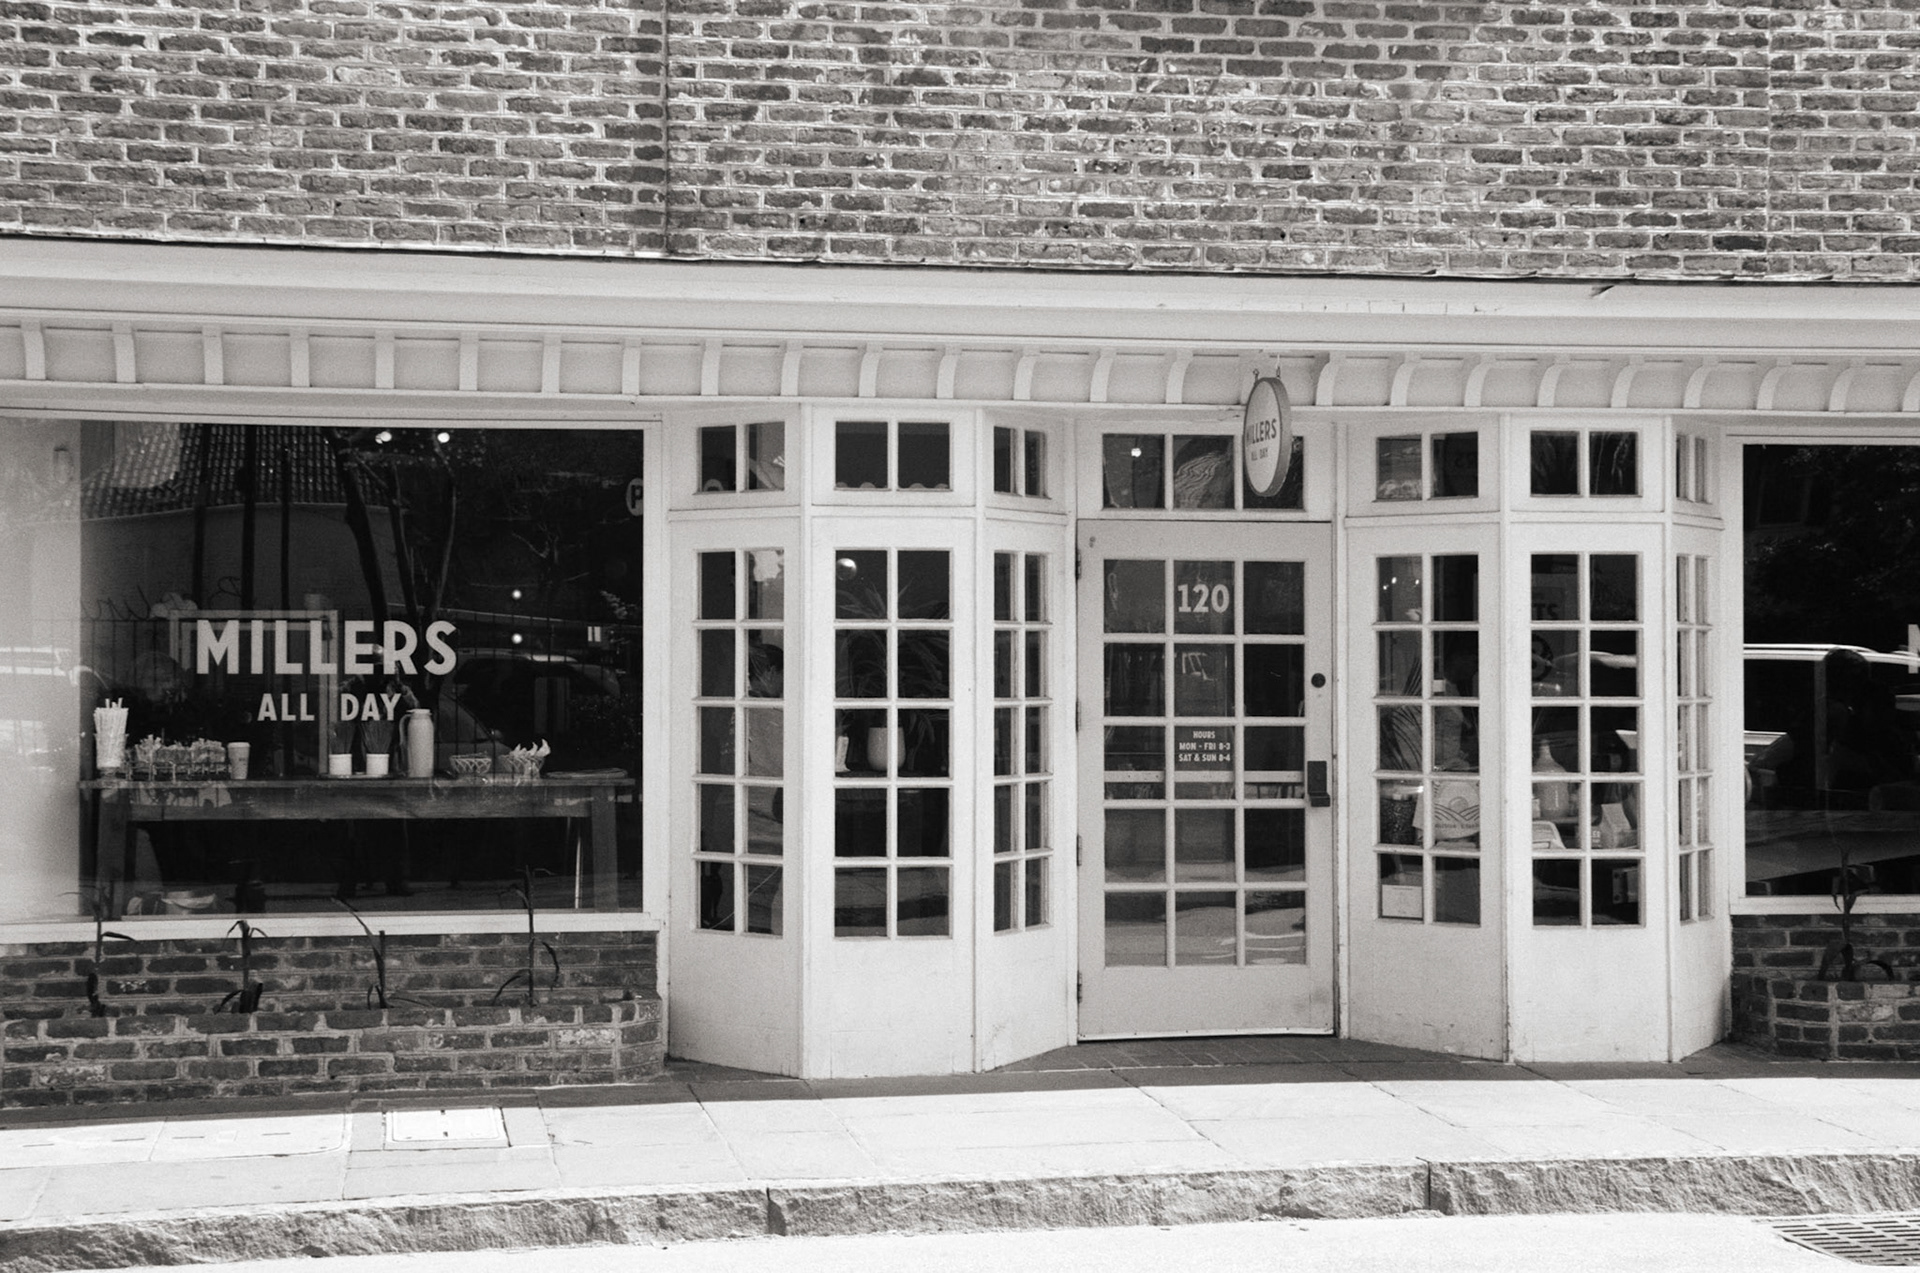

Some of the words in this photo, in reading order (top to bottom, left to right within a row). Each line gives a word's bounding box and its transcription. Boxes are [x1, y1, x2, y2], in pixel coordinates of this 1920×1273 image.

[1177, 584, 1230, 613] 120
[196, 620, 457, 675] MILLERS
[257, 693, 315, 721] ALL
[340, 693, 402, 721] DAY
[1193, 731, 1216, 739] HOURS
[1179, 742, 1197, 750] MON
[1204, 742, 1216, 750] FRI
[1178, 753, 1192, 762] SAT
[1194, 753, 1200, 762] &
[1202, 753, 1217, 762] SUN
